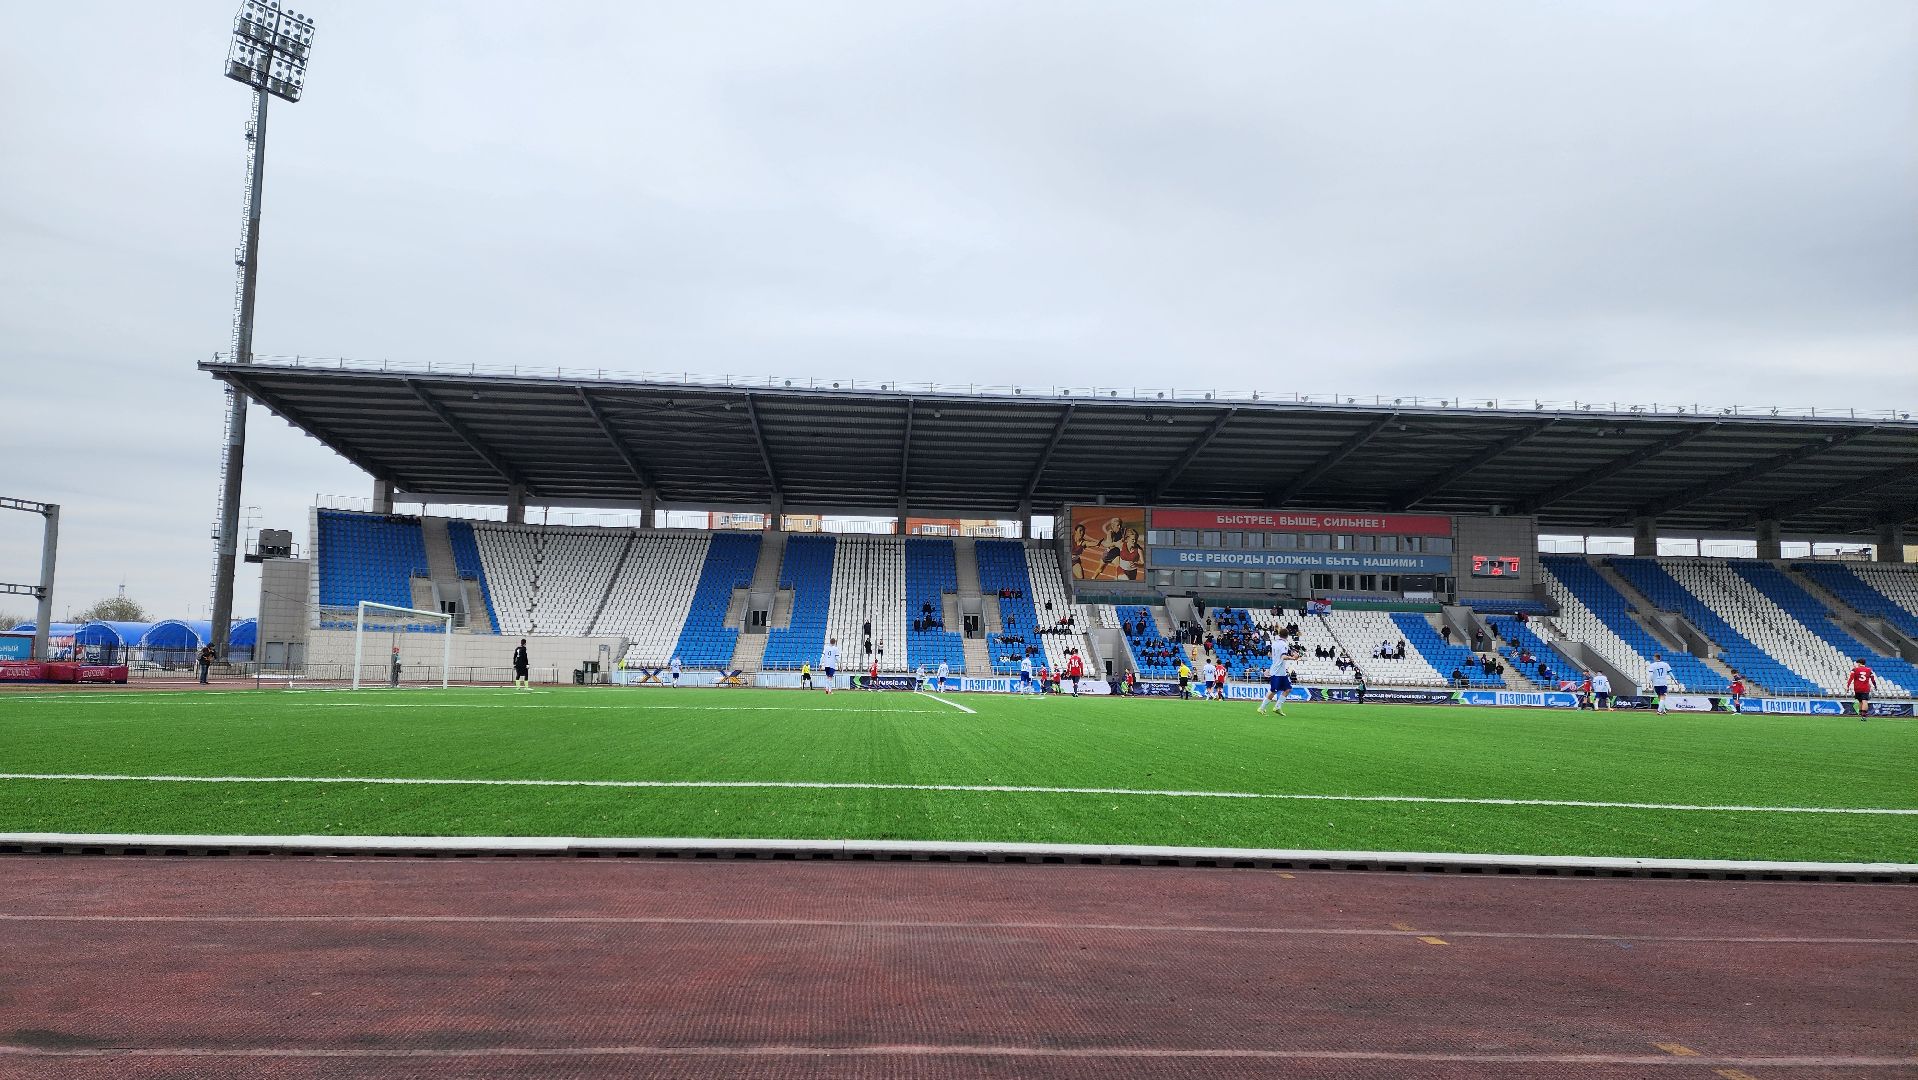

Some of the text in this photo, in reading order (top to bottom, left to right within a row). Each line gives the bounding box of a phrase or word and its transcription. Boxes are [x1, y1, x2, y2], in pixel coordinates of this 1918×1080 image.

[1216, 515, 1276, 526] БЫСТРЕЕ,
[1279, 516, 1321, 528] ВЫШЕ,
[1323, 518, 1379, 528] СИЛЬНЕЕ
[1180, 552, 1203, 562] ВСЕ
[1206, 553, 1264, 565] РЕКОРДЫ
[1266, 555, 1323, 566] ДОЛЖНЫ
[1325, 556, 1360, 566] БЫТЬ
[1363, 558, 1417, 568] НАШИМИ
[1474, 561, 1482, 571] 2
[1511, 562, 1518, 572] 0
[1858, 671, 1867, 682] 3
[965, 679, 1006, 691] ГАЗПРОМ
[1500, 693, 1541, 705] ГАЗПРОМ
[1765, 701, 1807, 712] ГАЗПРОМ
